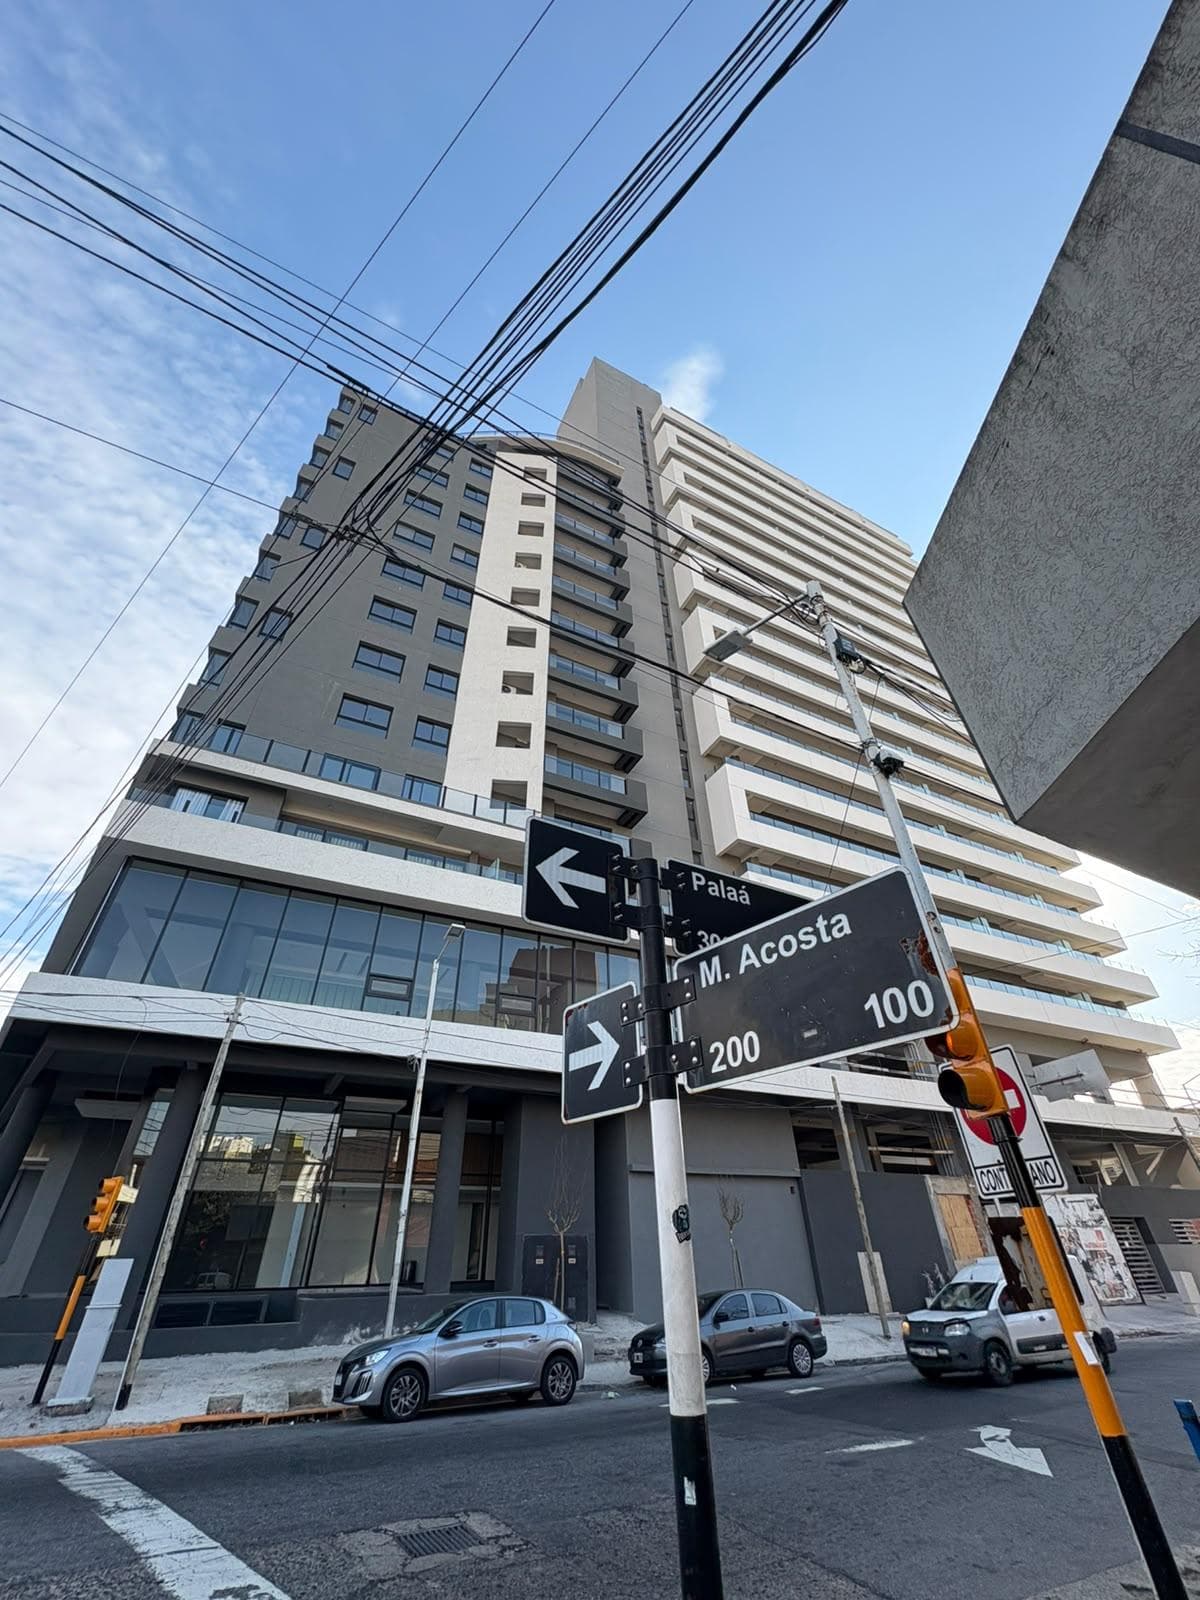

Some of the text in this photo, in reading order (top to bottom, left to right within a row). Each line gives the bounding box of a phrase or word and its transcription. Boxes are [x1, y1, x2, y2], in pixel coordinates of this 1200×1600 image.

[692, 872, 751, 905] Palaá
[699, 913, 852, 988] M. Acosta
[864, 979, 934, 1029] 100
[709, 1031, 760, 1074] 200
[980, 1160, 1056, 1191] CONTANO
